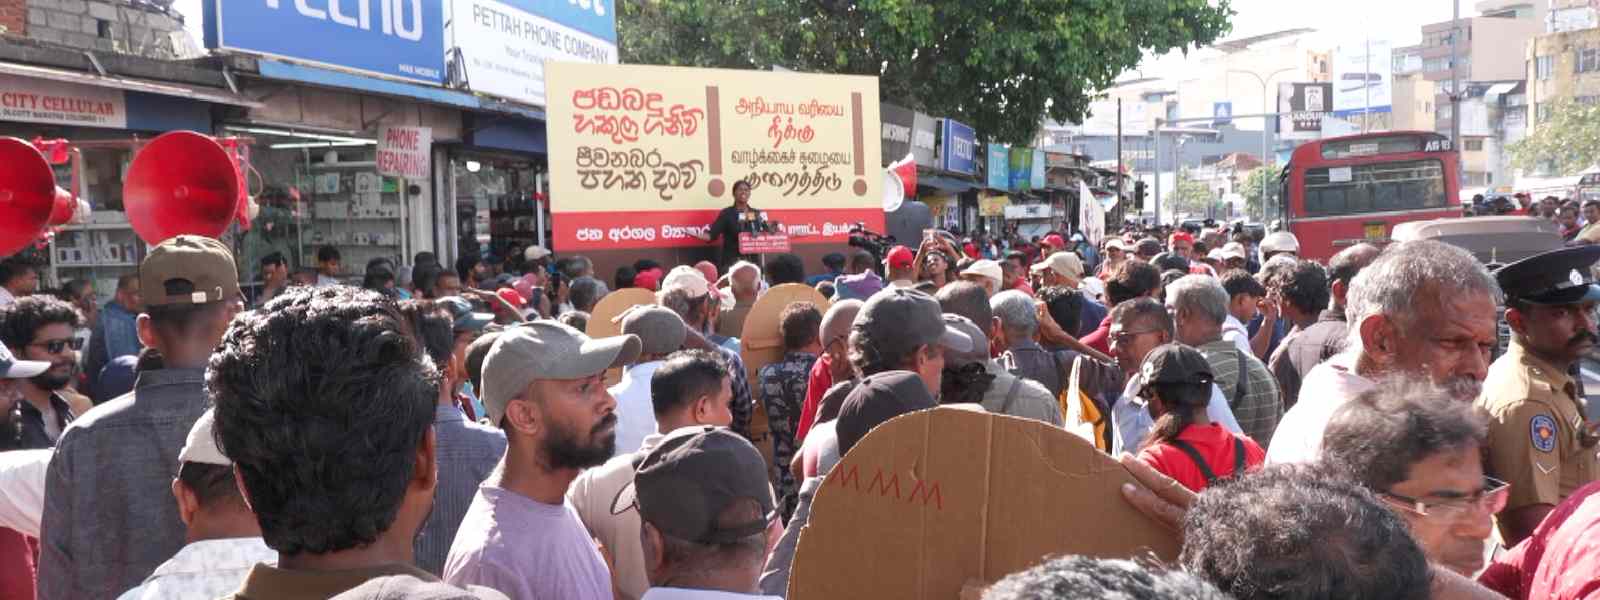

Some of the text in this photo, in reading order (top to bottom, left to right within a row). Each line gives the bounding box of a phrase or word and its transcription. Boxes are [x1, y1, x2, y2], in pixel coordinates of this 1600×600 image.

[473, 4, 608, 64] PETTAH PHONE COMPANY
[2, 92, 114, 115] CITY CELLULAR
[384, 127, 419, 150] PHONE
[768, 115, 815, 149] நீக்கு
[378, 150, 427, 176] REPAIRING
[576, 228, 603, 241] ජන
